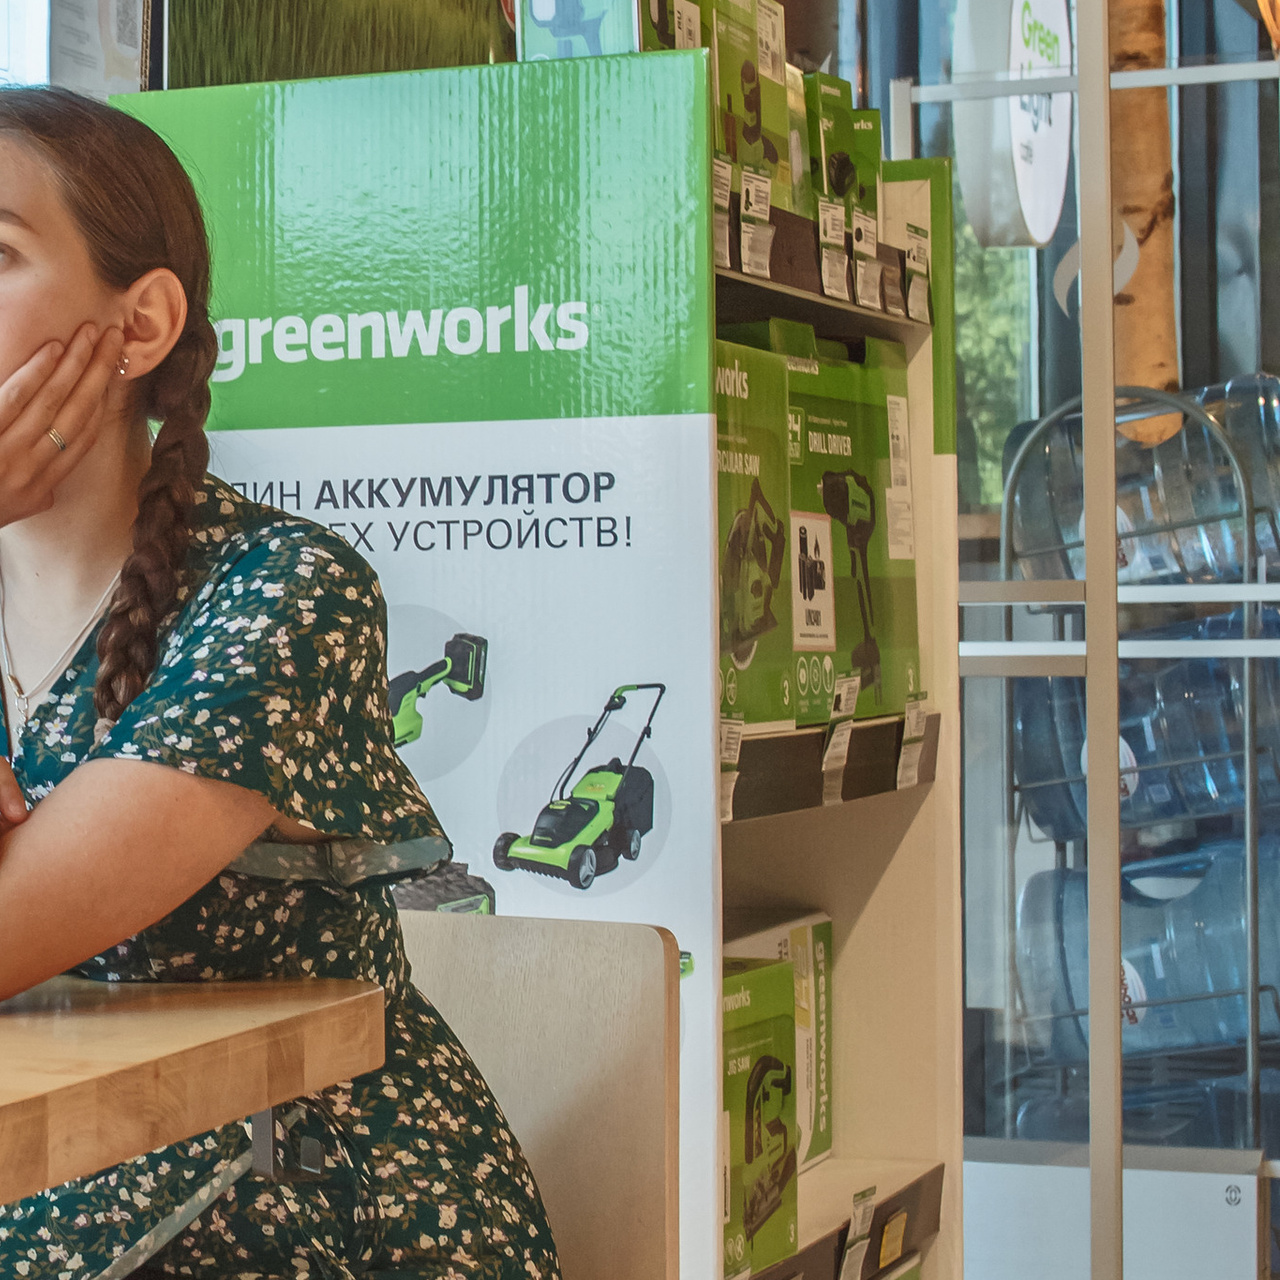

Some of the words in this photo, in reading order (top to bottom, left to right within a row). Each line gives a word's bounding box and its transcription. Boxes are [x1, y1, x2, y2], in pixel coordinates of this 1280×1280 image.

[1021, 0, 1060, 69] Green
[212, 284, 590, 383] greenworks
[715, 359, 749, 400] works
[717, 450, 743, 474] RCULAR
[744, 454, 760, 477] SAW
[808, 431, 828, 454] DRILL
[828, 433, 852, 457] DRIVER
[314, 472, 616, 510] АККУМУЛЯТОР
[385, 509, 632, 552] УСТРОЙСТВ!
[783, 679, 789, 706] 3
[815, 940, 828, 1133] greenworks
[727, 1059, 737, 1076] JIG
[737, 1055, 751, 1073] SAW
